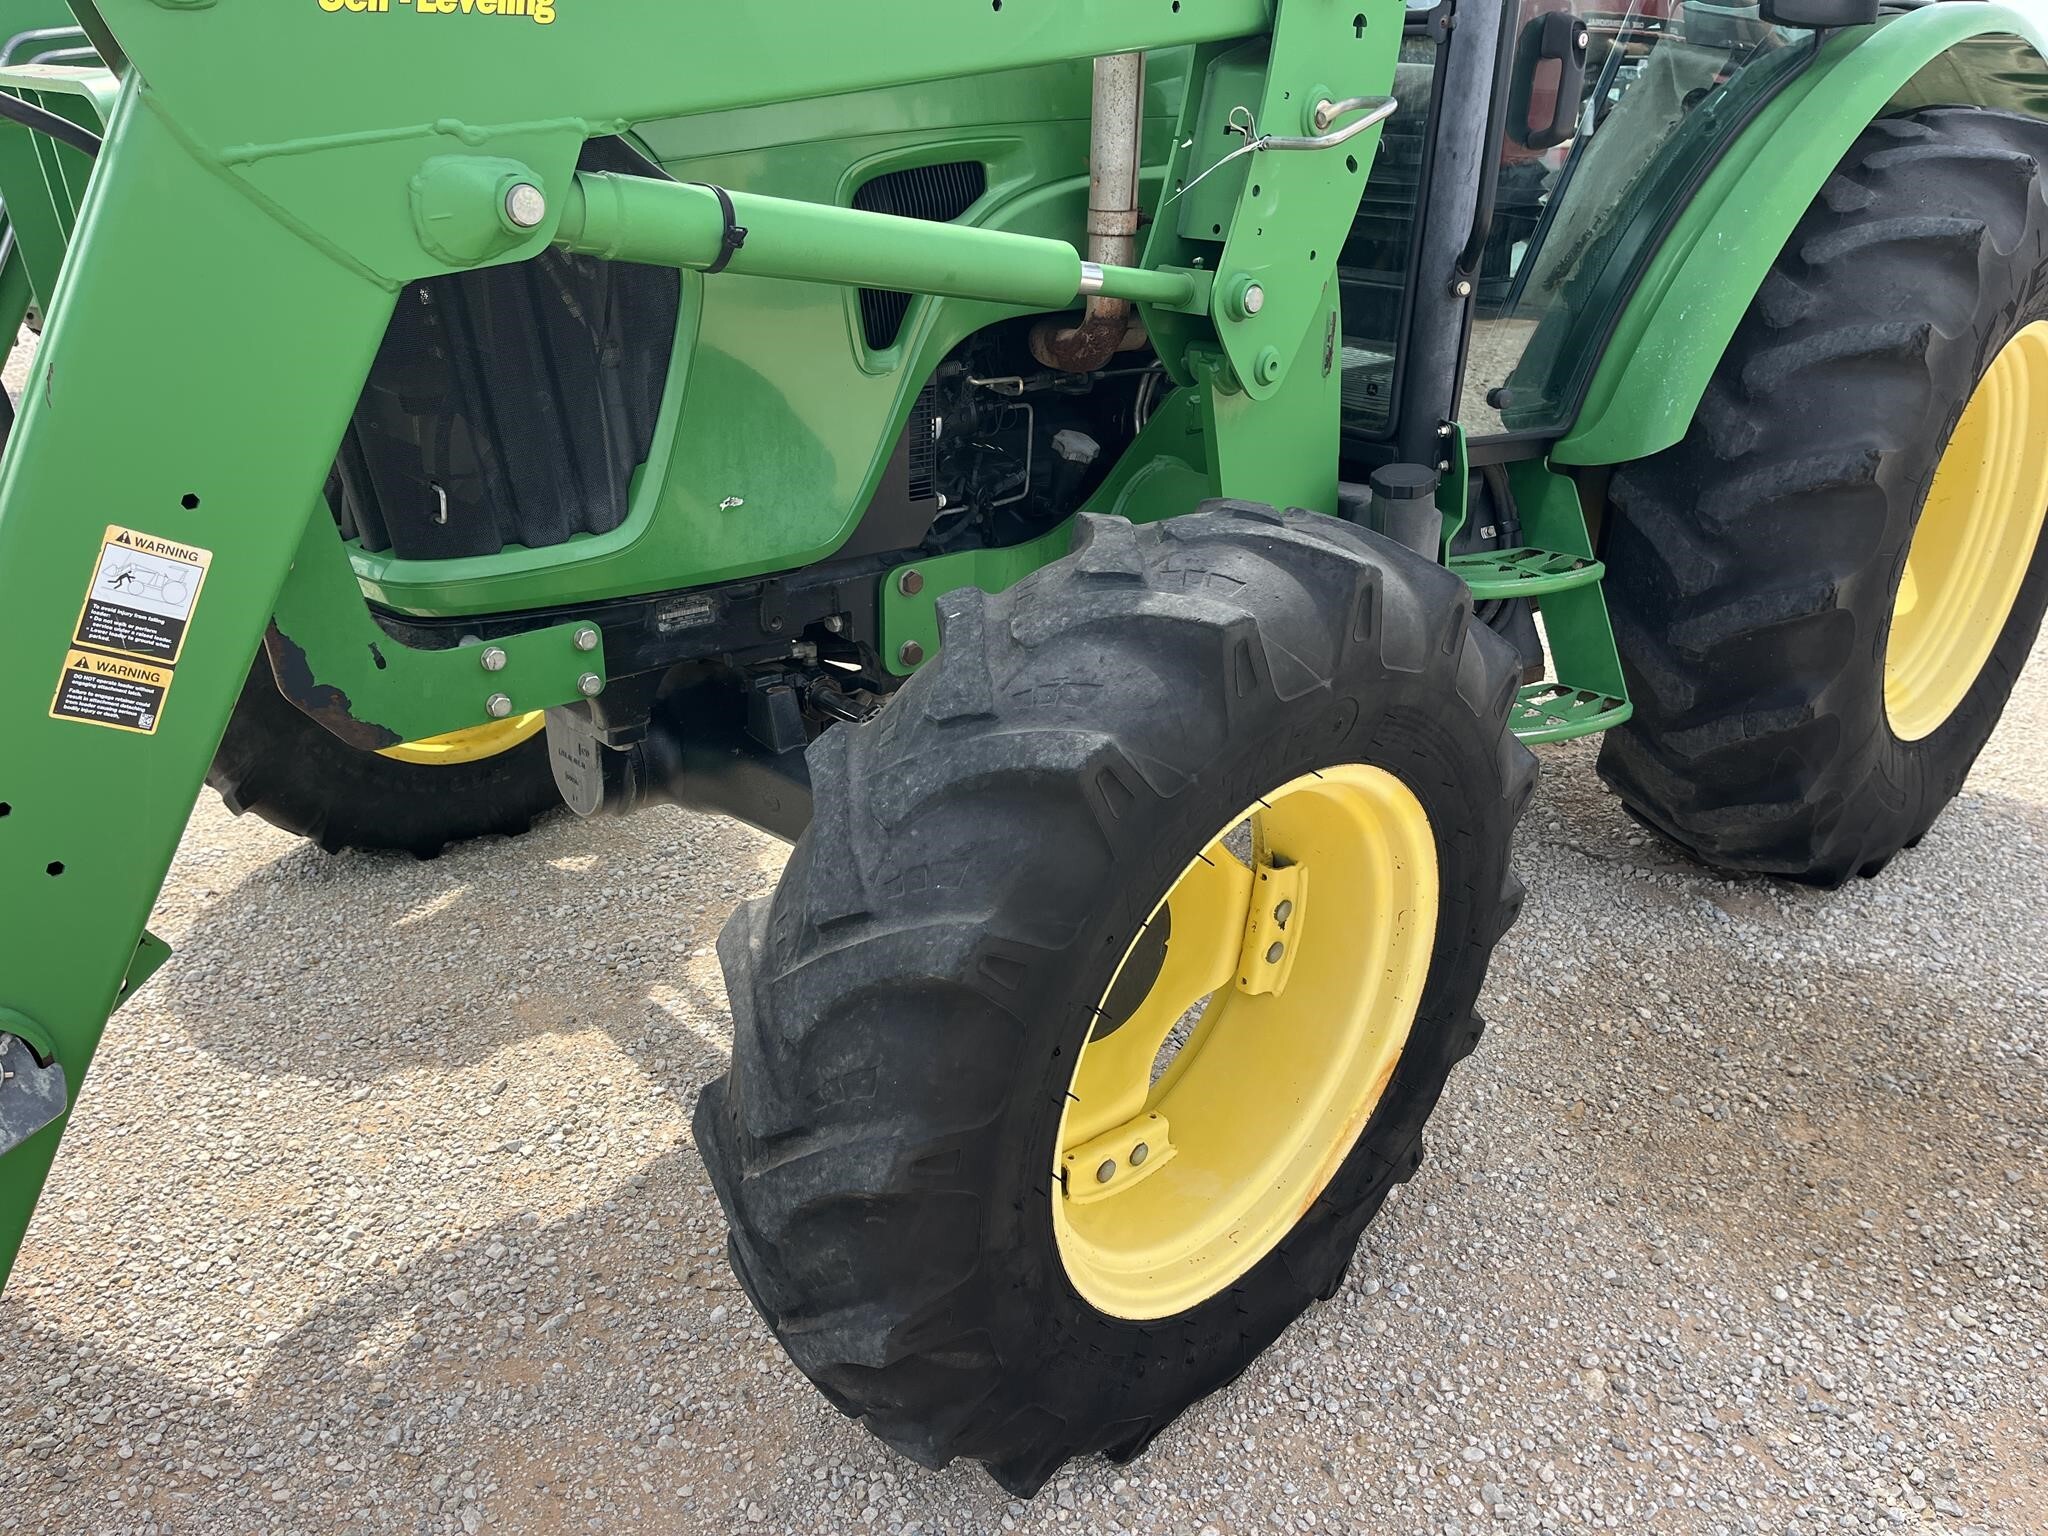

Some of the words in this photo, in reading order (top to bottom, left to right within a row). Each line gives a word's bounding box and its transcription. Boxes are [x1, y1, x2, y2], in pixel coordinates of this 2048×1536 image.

[135, 537, 198, 561] WARNING
[101, 605, 116, 613] avoid
[117, 609, 134, 618] injury
[148, 616, 165, 625] falling
[90, 627, 108, 635] Lower
[135, 637, 155, 645] ground
[92, 622, 113, 630] service
[136, 631, 153, 639] raised
[135, 625, 157, 634] perform
[97, 661, 160, 682] WARNING
[69, 688, 87, 696] Failure
[118, 681, 135, 690] loader
[135, 685, 155, 693] without
